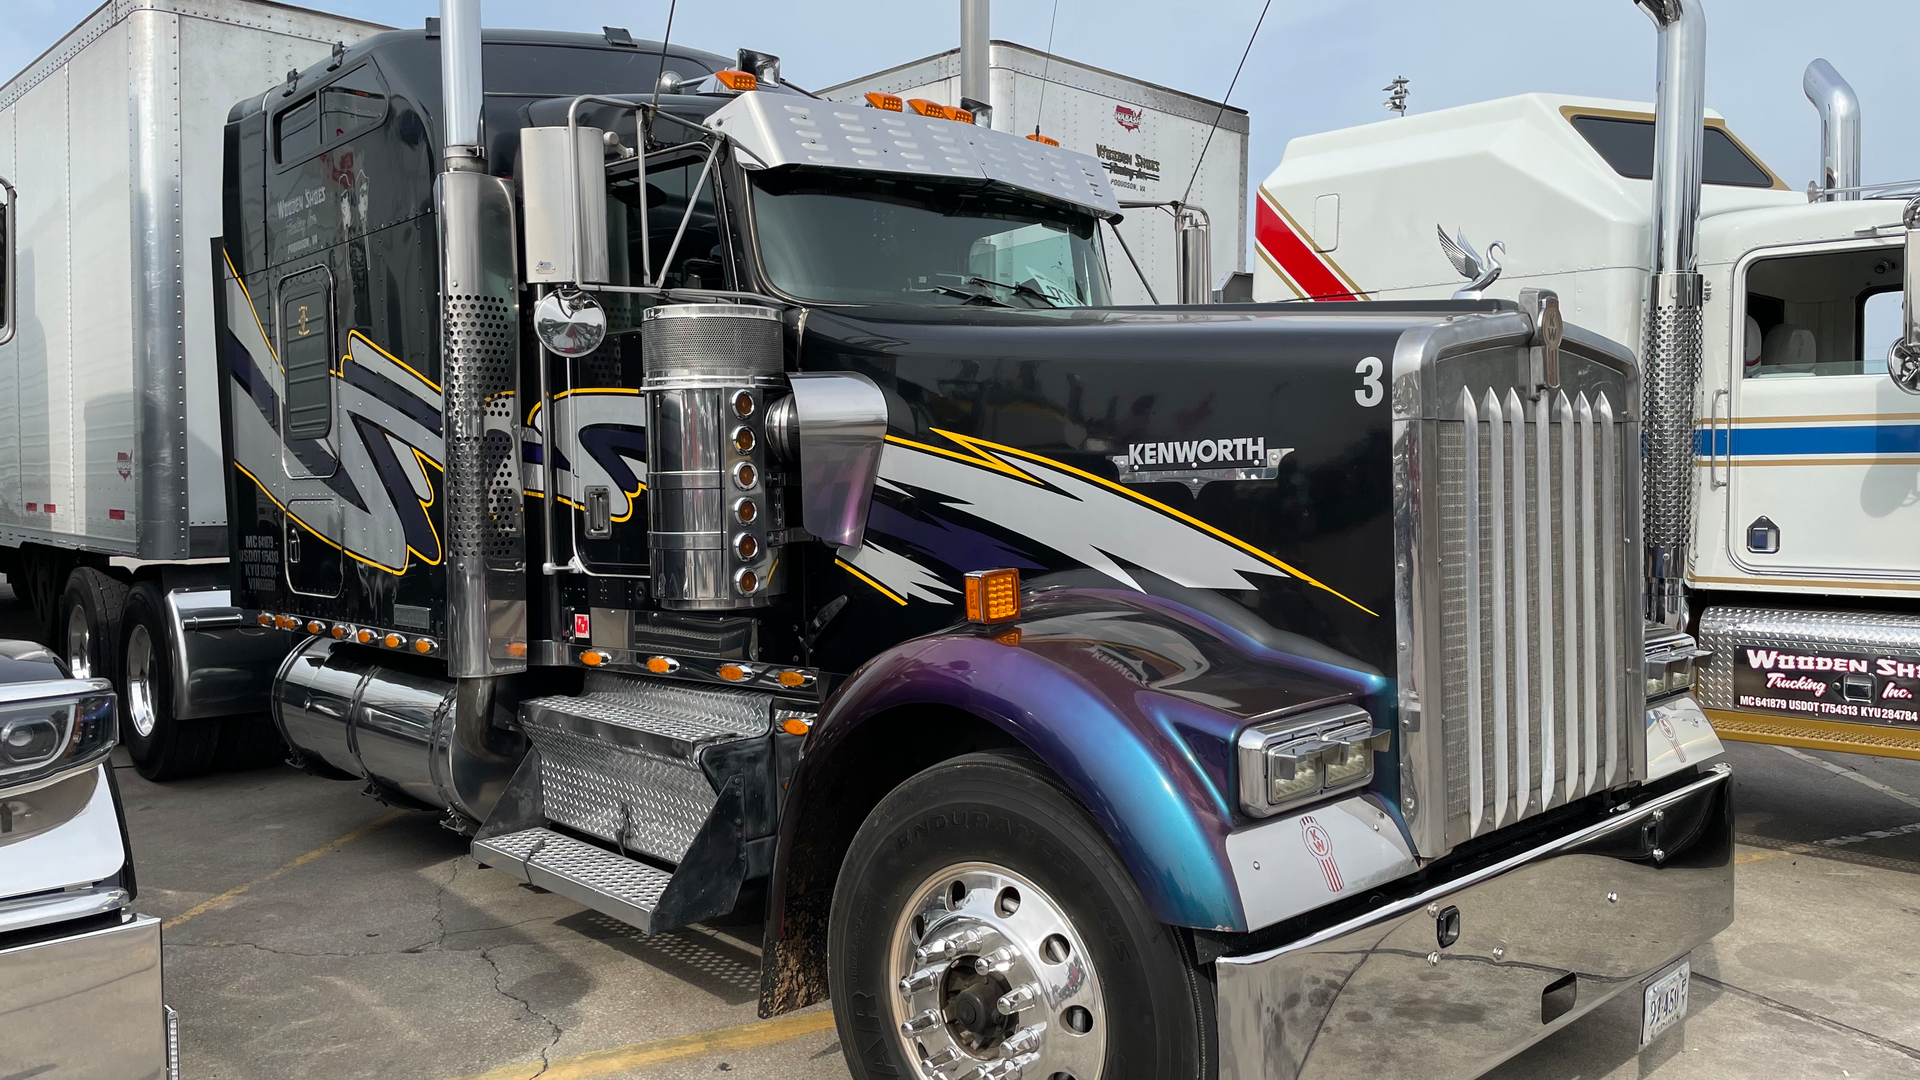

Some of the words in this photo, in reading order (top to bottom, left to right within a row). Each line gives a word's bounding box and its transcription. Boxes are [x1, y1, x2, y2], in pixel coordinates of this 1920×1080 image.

[1354, 356, 1384, 408] 3
[1128, 436, 1265, 466] KENWORTH
[1746, 649, 1868, 674] WOODEN
[1766, 672, 1828, 698] Trucking
[1881, 681, 1914, 699] Inc.
[1739, 695, 1755, 706] MC
[1755, 696, 1787, 709] 641879
[1788, 700, 1820, 712] USDOT
[1820, 703, 1858, 716] 1754313
[1860, 707, 1881, 718] KYU
[1881, 709, 1919, 722] 284784
